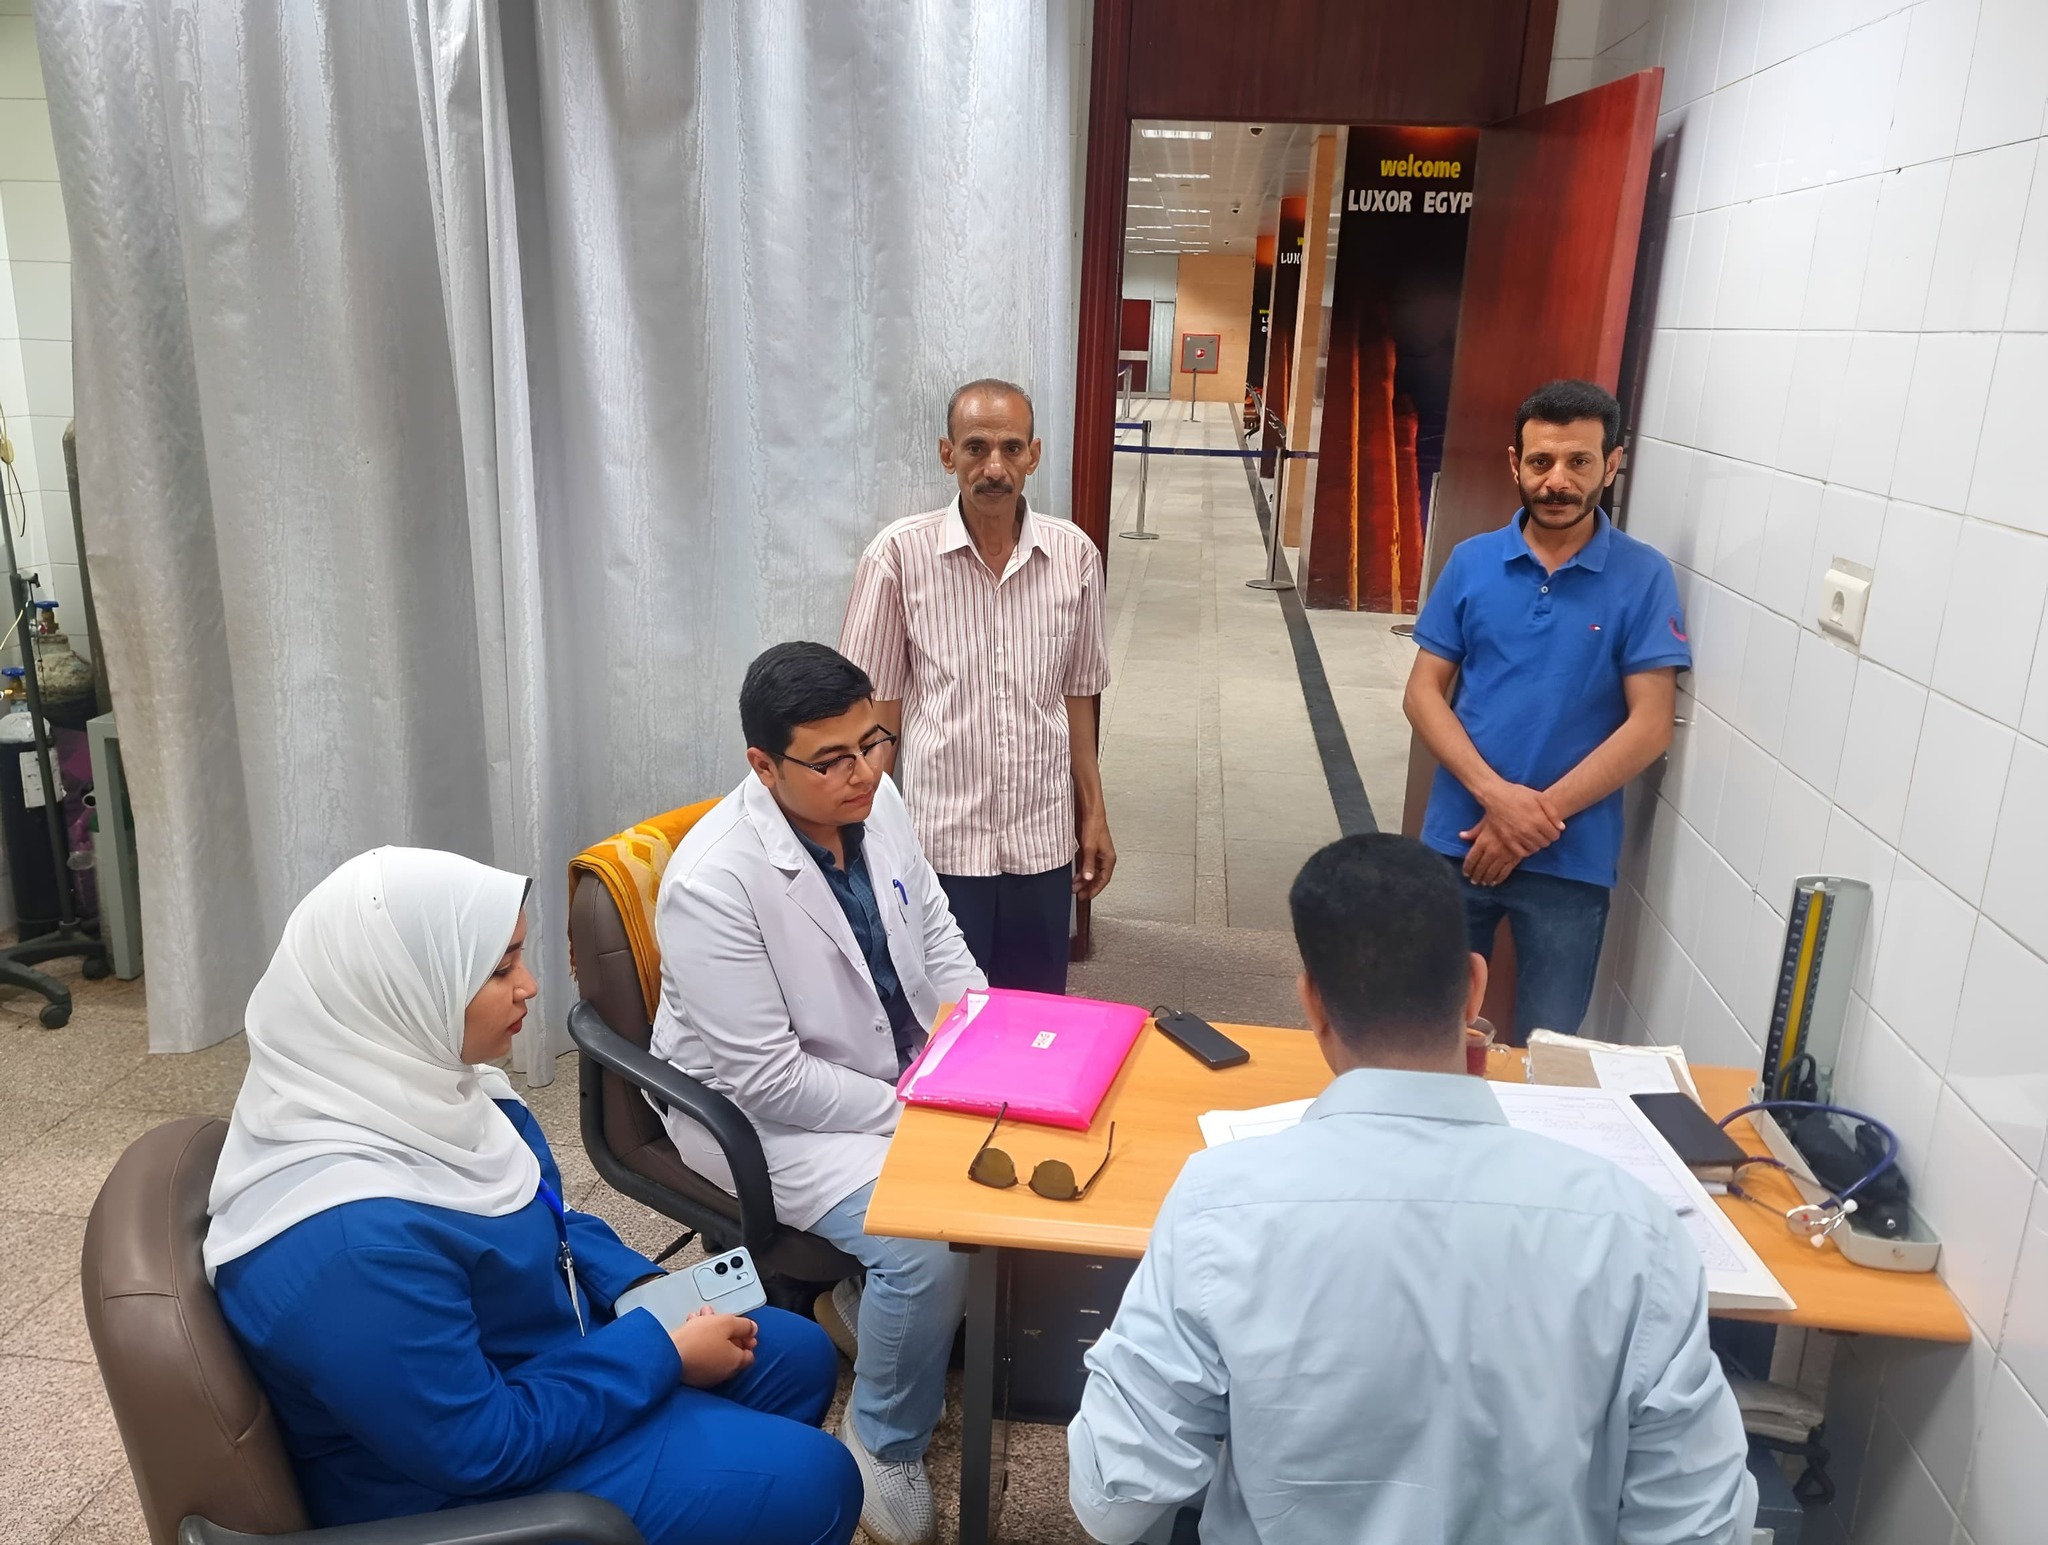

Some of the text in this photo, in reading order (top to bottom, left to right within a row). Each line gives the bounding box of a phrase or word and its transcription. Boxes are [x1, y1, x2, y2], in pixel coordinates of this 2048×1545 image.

[1380, 153, 1461, 179] welcome
[1347, 189, 1473, 214] LUXOR EGYP
[1280, 252, 1302, 265] LUX
